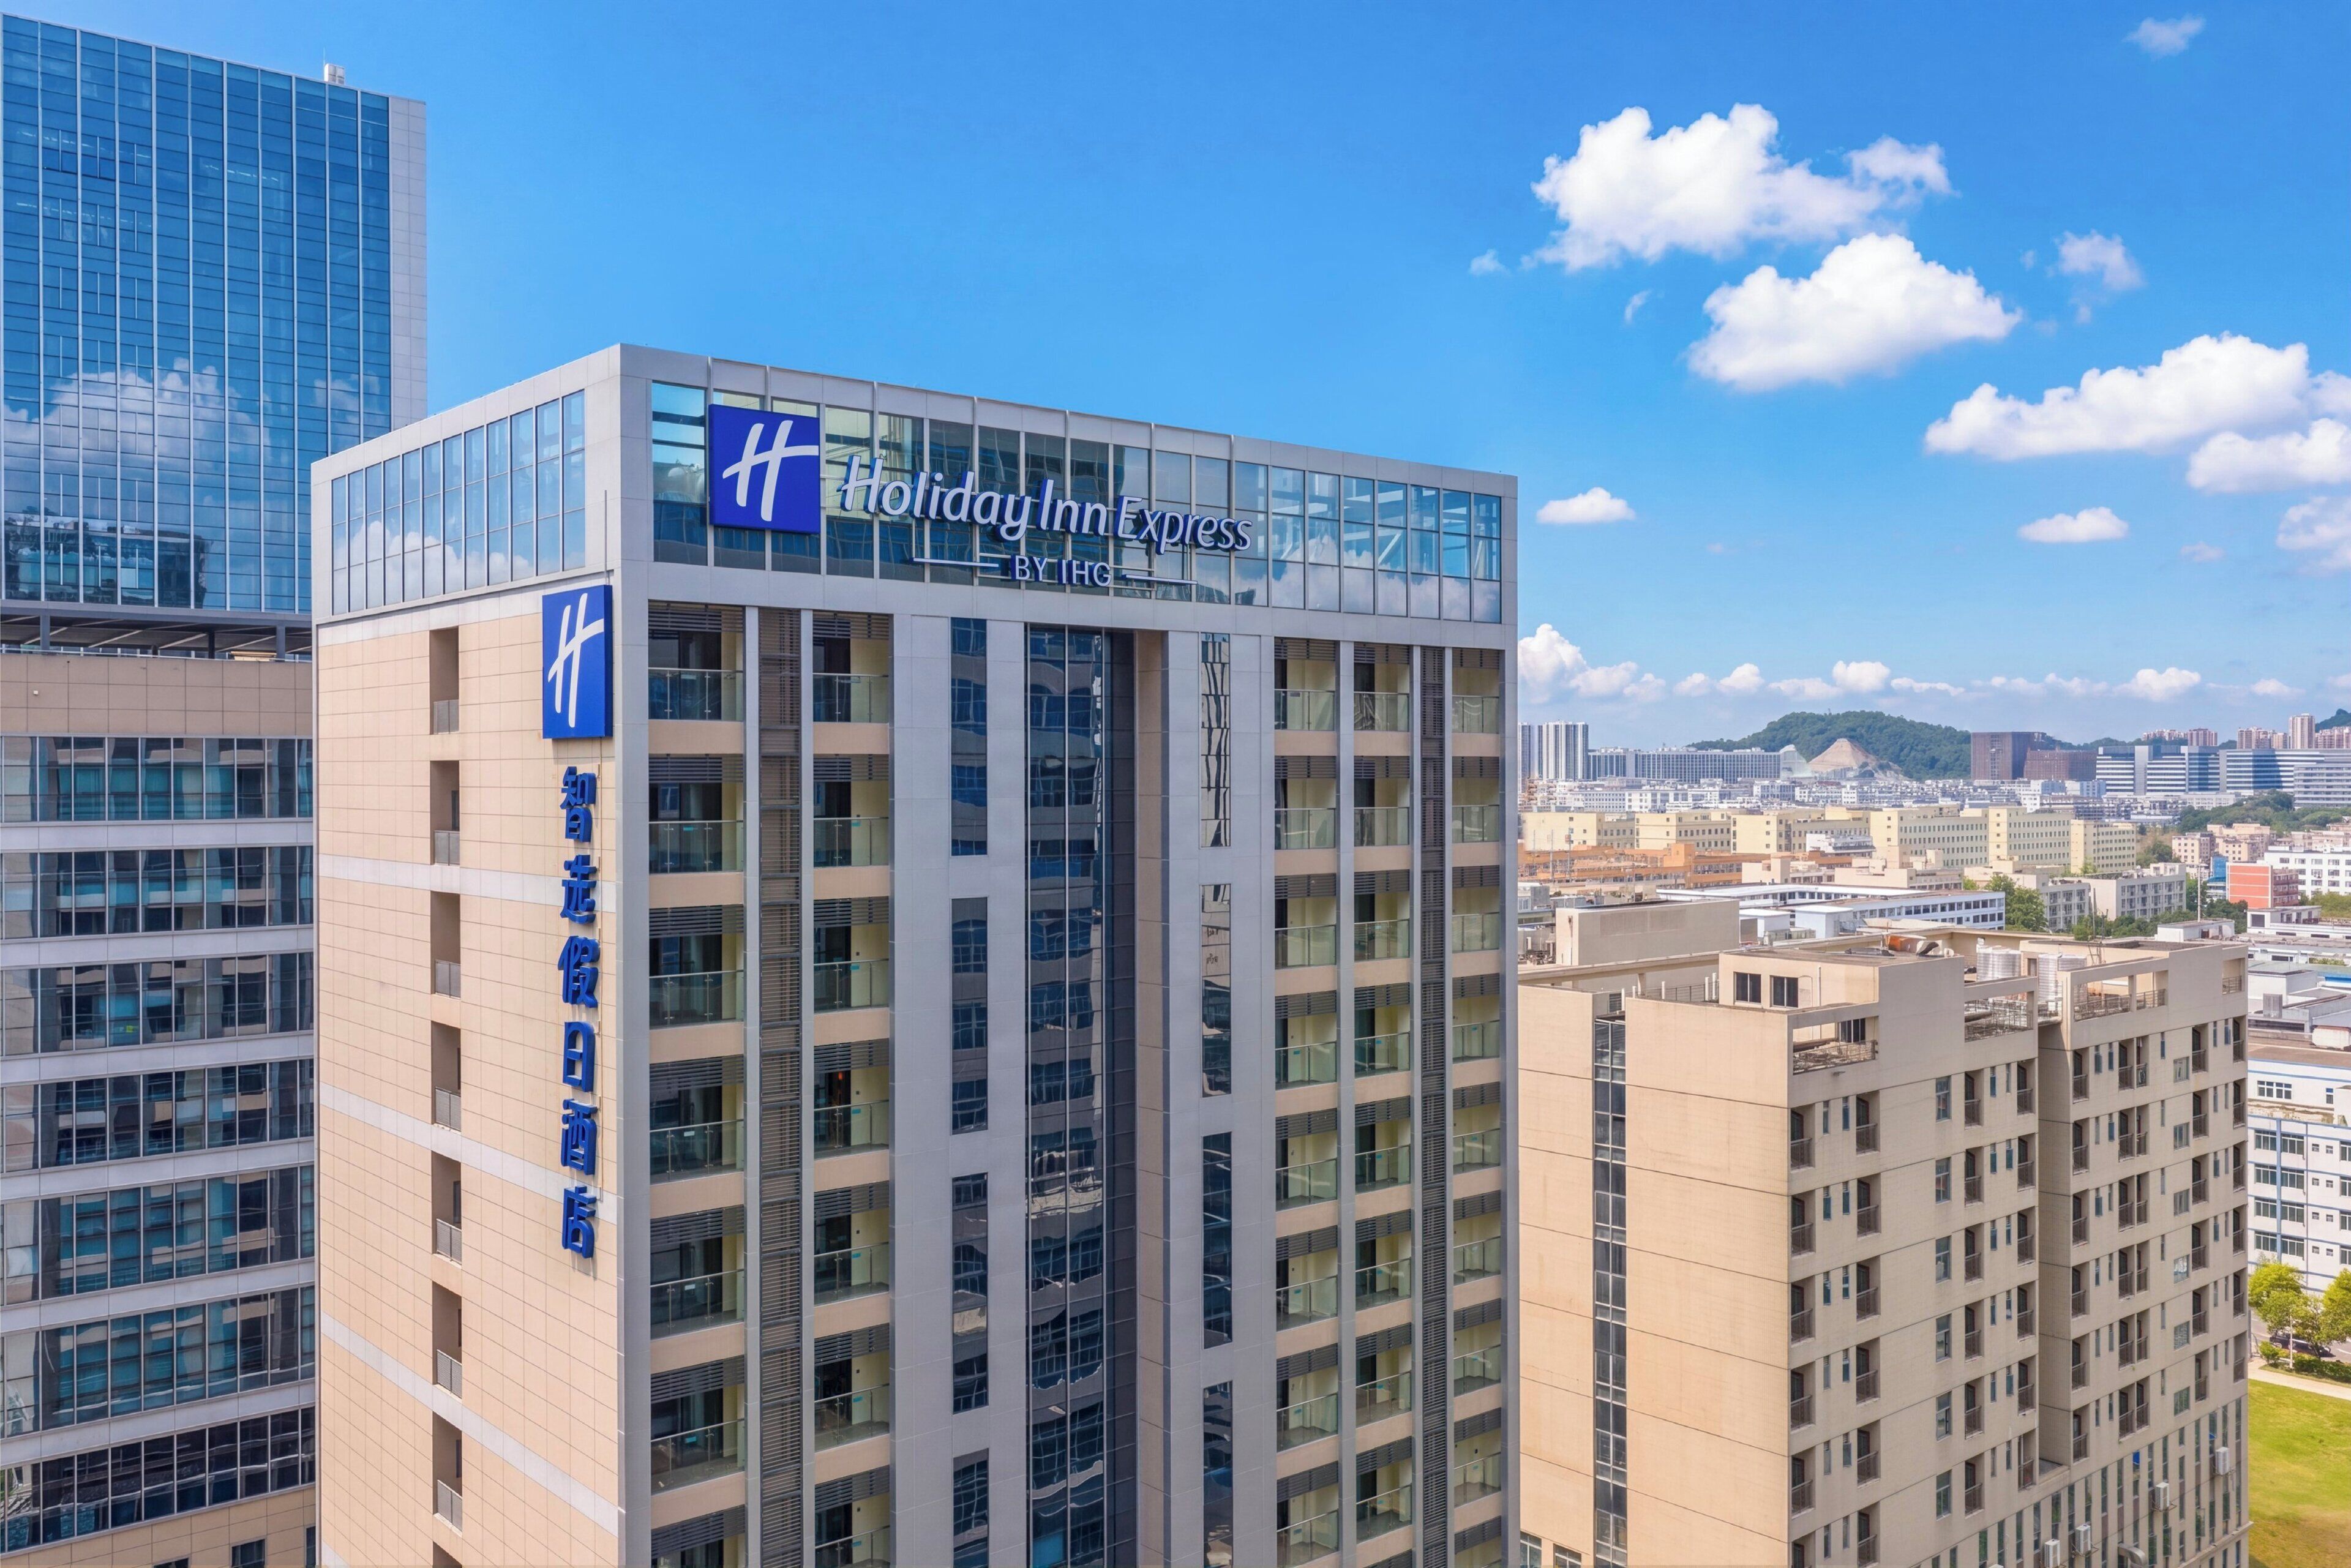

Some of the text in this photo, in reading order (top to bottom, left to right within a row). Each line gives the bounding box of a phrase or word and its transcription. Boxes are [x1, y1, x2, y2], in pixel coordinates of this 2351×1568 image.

[837, 454, 1253, 555] Holiday Inn Express
[1012, 555, 1112, 587] BY IHG
[558, 766, 599, 1259] 智选假日酒店
